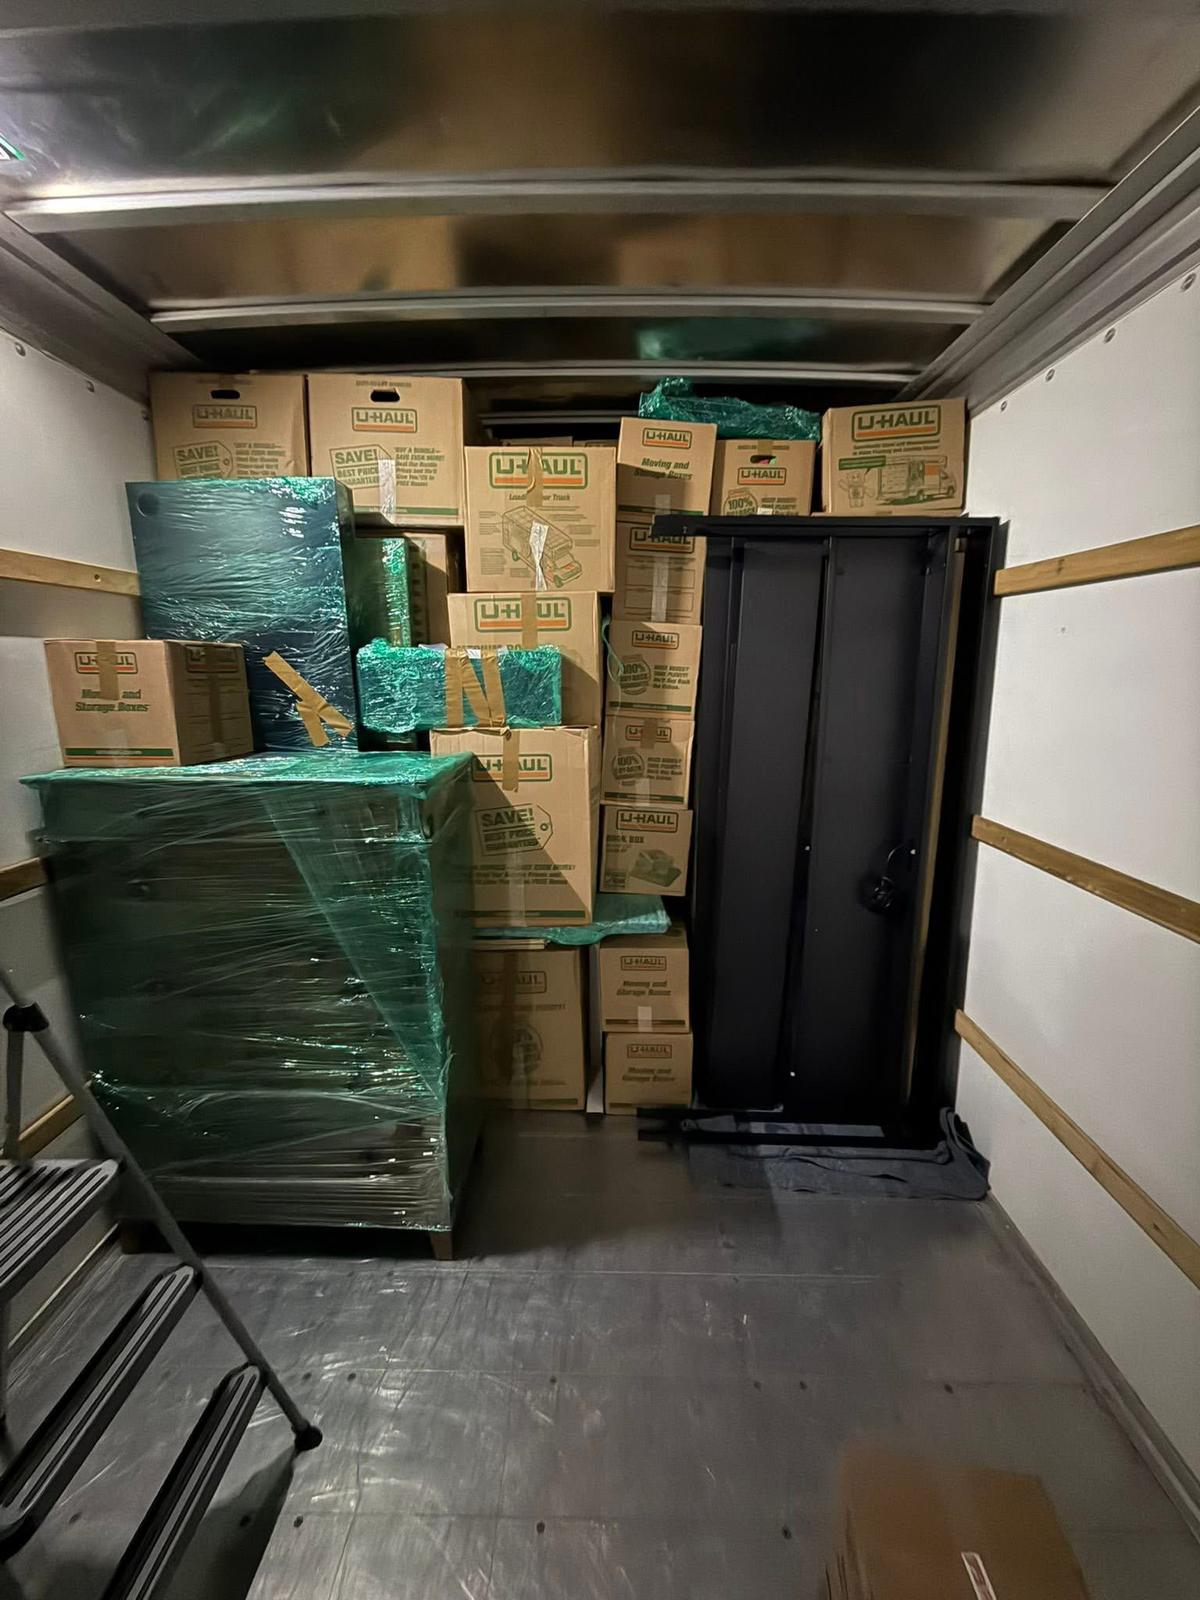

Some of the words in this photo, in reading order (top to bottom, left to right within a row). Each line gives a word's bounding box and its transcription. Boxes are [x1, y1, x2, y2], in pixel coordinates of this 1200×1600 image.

[197, 407, 254, 420] U-HAUL
[356, 411, 414, 424] U-HAUL
[858, 410, 935, 430] U-HAUL
[646, 430, 689, 442] U-HAUL
[176, 445, 219, 461] SAVE!
[335, 448, 378, 465] SAVE!
[641, 457, 672, 470] Moving
[673, 461, 689, 469] and
[741, 470, 784, 479] U-HAUL
[727, 496, 754, 510] 100%
[480, 602, 566, 619] U-HUL
[635, 633, 676, 643] U-HAUL
[118, 701, 151, 711] Boxes
[481, 808, 534, 827] SAVE!
[620, 812, 675, 825] U-HAUL
